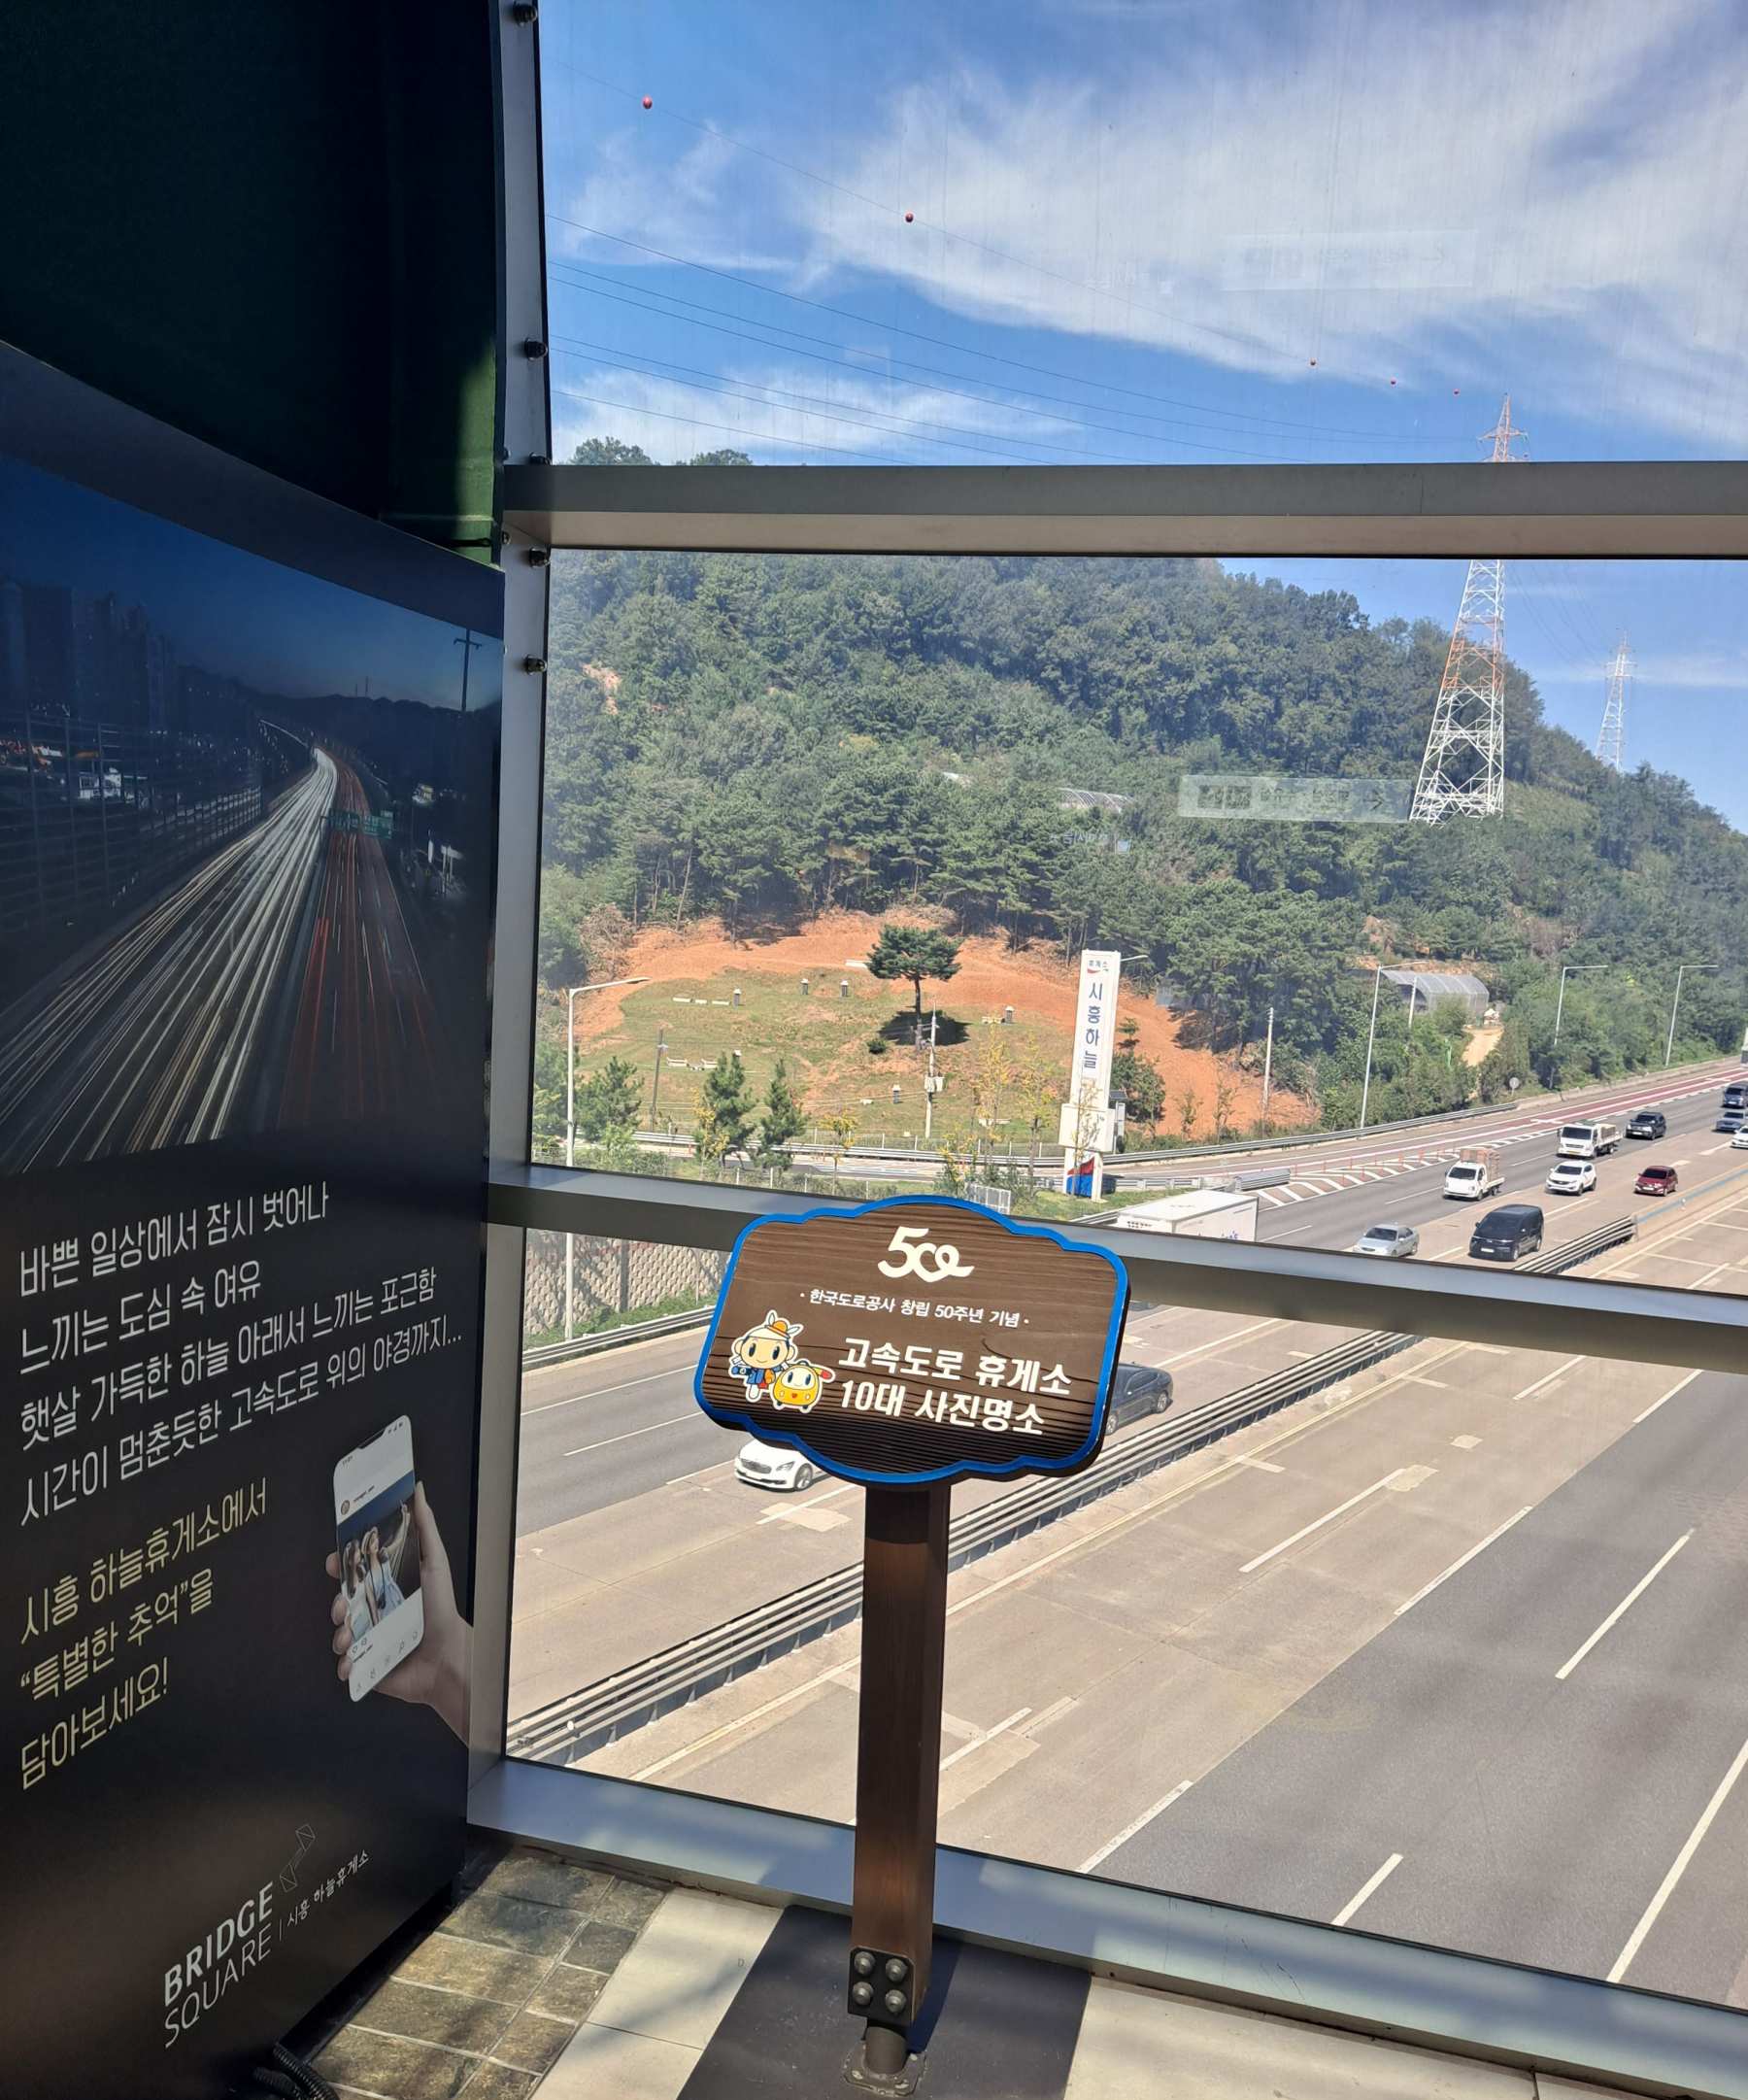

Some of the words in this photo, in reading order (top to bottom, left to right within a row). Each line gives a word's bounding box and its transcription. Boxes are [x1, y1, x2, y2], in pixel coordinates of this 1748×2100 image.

[1084, 983, 1103, 1069] 시흥하늘
[20, 1237, 80, 1297] 바쁜
[91, 1209, 197, 1277] 일상에서
[207, 1197, 253, 1246] 잠시
[262, 1181, 329, 1232] 벗어나
[20, 1311, 109, 1375] 느끼는
[118, 1283, 171, 1340] 도심
[181, 1277, 205, 1315] 속
[215, 1260, 261, 1307] 여유
[20, 1385, 81, 1451] 햇살
[90, 1355, 172, 1422] 가득한
[181, 1332, 229, 1386] 하늘
[238, 1308, 304, 1365] 아래서
[312, 1289, 373, 1340] 느끼는
[381, 1266, 436, 1314] 포근함
[809, 1288, 895, 1313] 한국도로공사
[900, 1300, 929, 1318] 창립
[934, 1304, 984, 1325] 50주년
[990, 1310, 1020, 1328] 기념
[838, 1336, 963, 1380] 고속도로
[975, 1354, 1072, 1396] 휴게소
[20, 1444, 107, 1527] 시간이
[119, 1400, 221, 1481] 멈춘듯한
[229, 1361, 319, 1432] 고속도로
[326, 1342, 365, 1389] 위의
[838, 1379, 904, 1417] 10대
[915, 1389, 1045, 1436] 사진명소
[20, 1573, 80, 1644] 시흥
[90, 1477, 267, 1601] 하늘휴게소에서
[20, 1657, 169, 1791] 담아보세요!
[164, 1880, 274, 2008] BRIDGE
[287, 1900, 311, 1927] 시흥
[314, 1849, 371, 1904] 하늘휴게소
[164, 1922, 272, 2049] SQUARE
